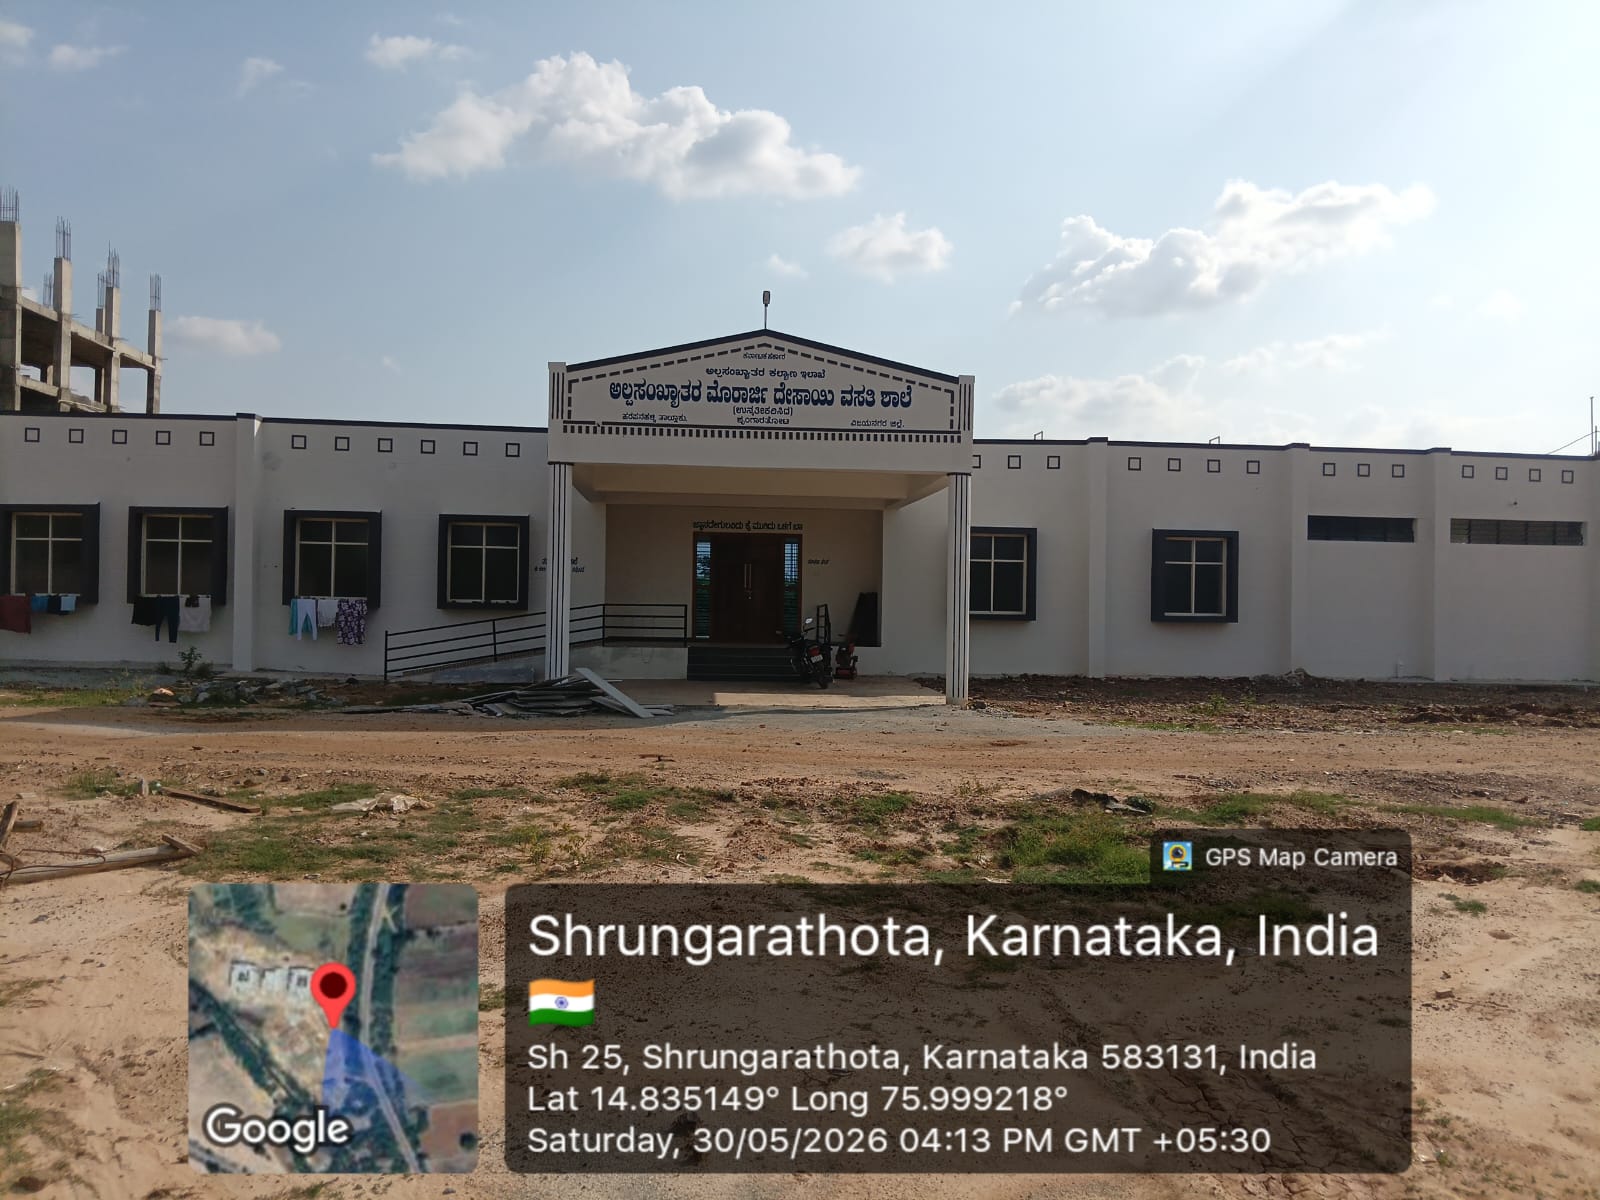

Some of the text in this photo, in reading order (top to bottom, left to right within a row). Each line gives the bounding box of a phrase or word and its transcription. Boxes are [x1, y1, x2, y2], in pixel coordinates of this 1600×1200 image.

[609, 378, 702, 408] ಅಲ್ಪಸಂಖ್ಯಾತರ
[773, 382, 835, 406] ದೇಸಾಯಿ
[840, 384, 876, 407] ವಸತಿ
[880, 385, 912, 408] ಶಾಲೆ
